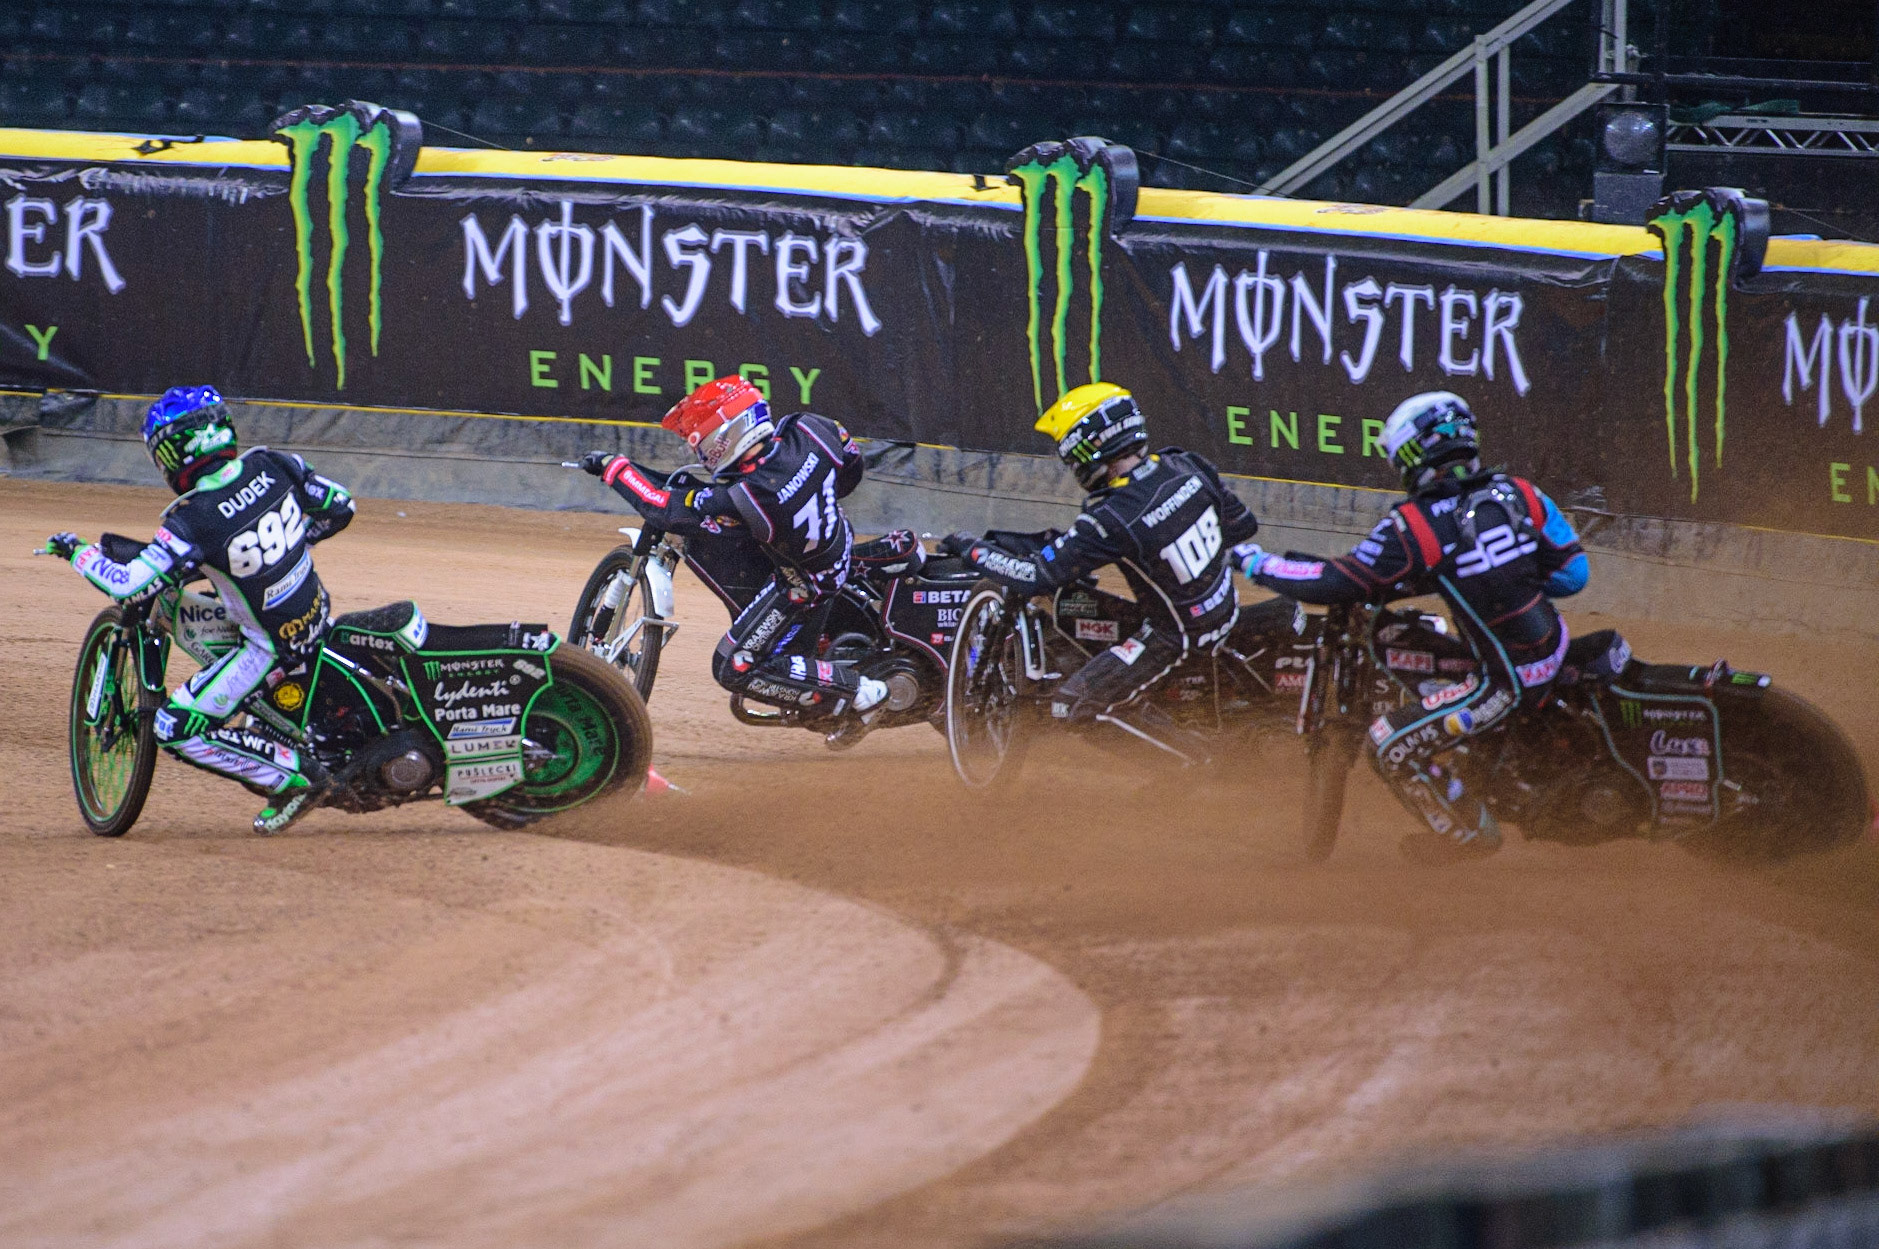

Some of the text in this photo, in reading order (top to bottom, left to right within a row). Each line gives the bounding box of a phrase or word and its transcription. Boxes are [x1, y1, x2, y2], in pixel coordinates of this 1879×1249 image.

[460, 200, 882, 336] MONSTER
[1170, 250, 1530, 397] MONSTER
[529, 350, 821, 405] ENERGY
[1226, 405, 1388, 459] ENER
[217, 470, 277, 519] DUDEK
[776, 451, 820, 505] JANOWSKI
[1141, 475, 1204, 529] WOFFINDEN
[227, 491, 305, 578] 692
[1159, 503, 1223, 585] 108
[180, 605, 227, 624] Nice
[928, 589, 972, 604] BETA
[341, 631, 395, 652] Bartex
[439, 658, 505, 672] MONSTER
[434, 702, 521, 721] Porta Mare
